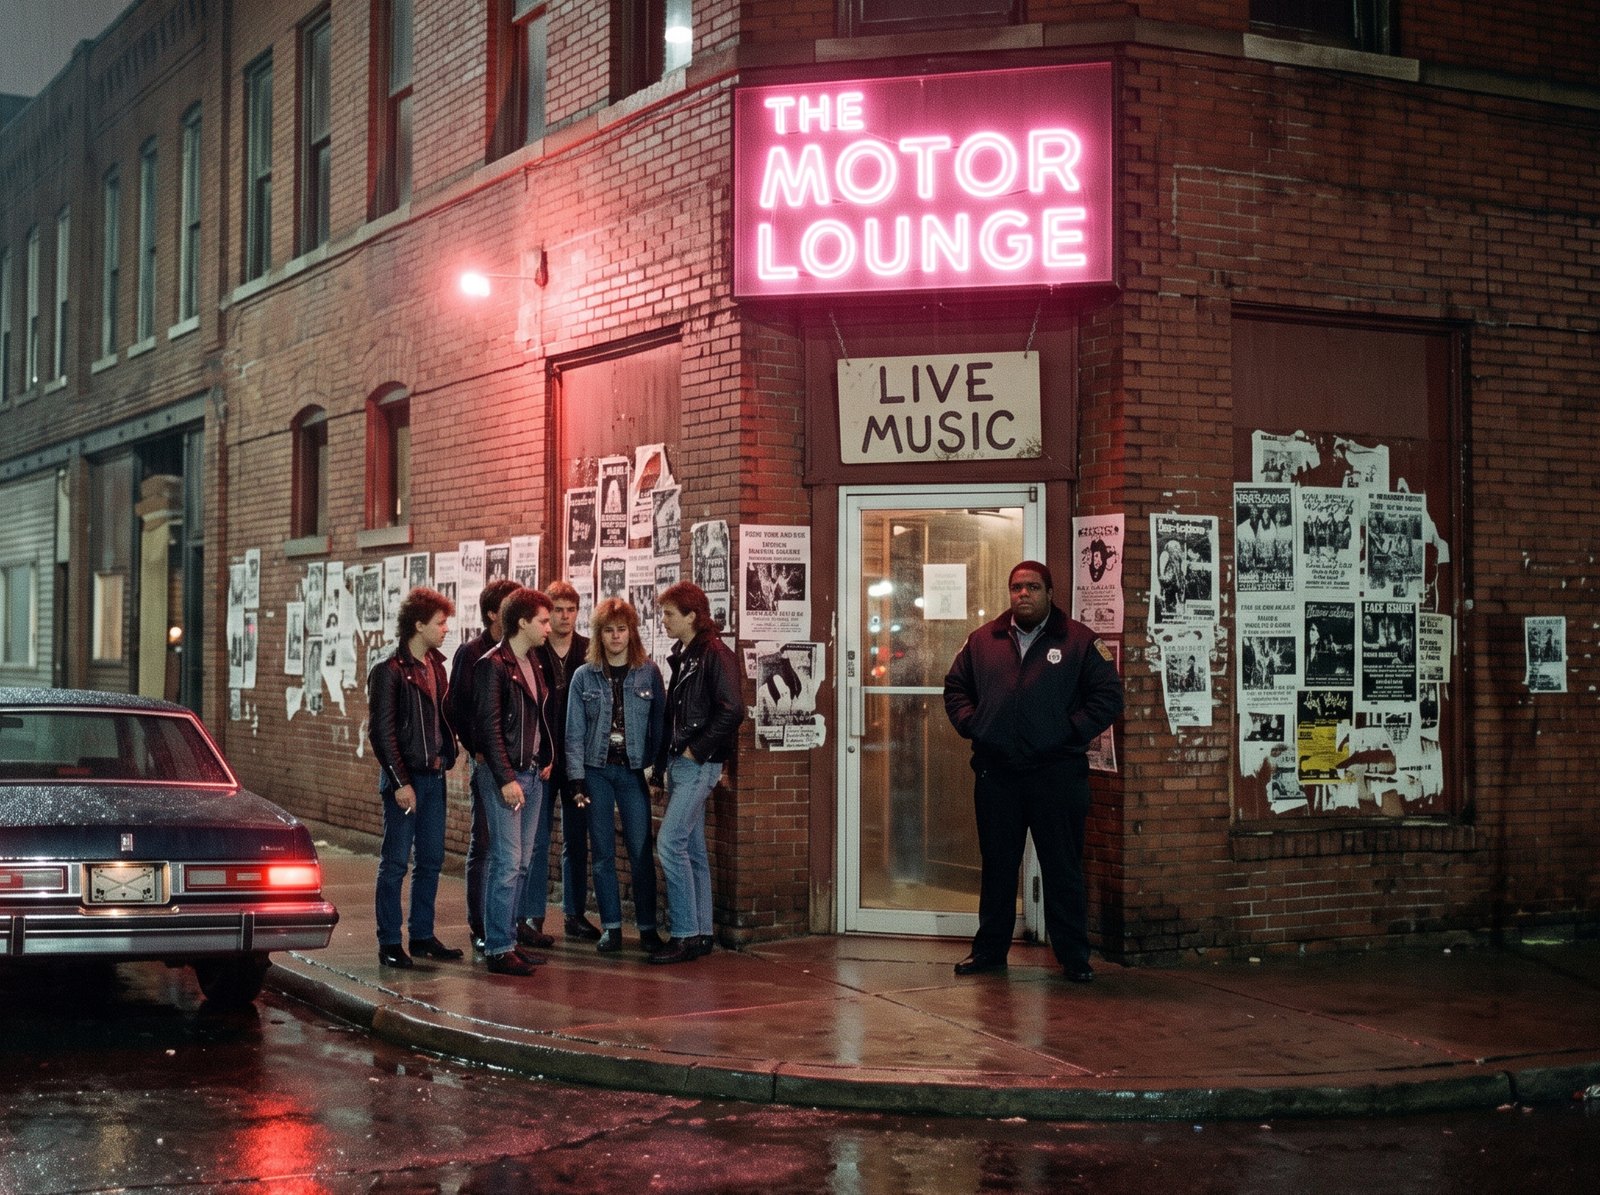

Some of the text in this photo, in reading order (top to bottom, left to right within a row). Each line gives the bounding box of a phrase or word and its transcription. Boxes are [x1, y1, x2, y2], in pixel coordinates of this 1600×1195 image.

[764, 91, 865, 135] THE
[759, 128, 1082, 209] MOTOR
[757, 207, 1087, 281] LOUNGE
[878, 361, 995, 405] LIVE
[861, 409, 1016, 454] MUSIC
